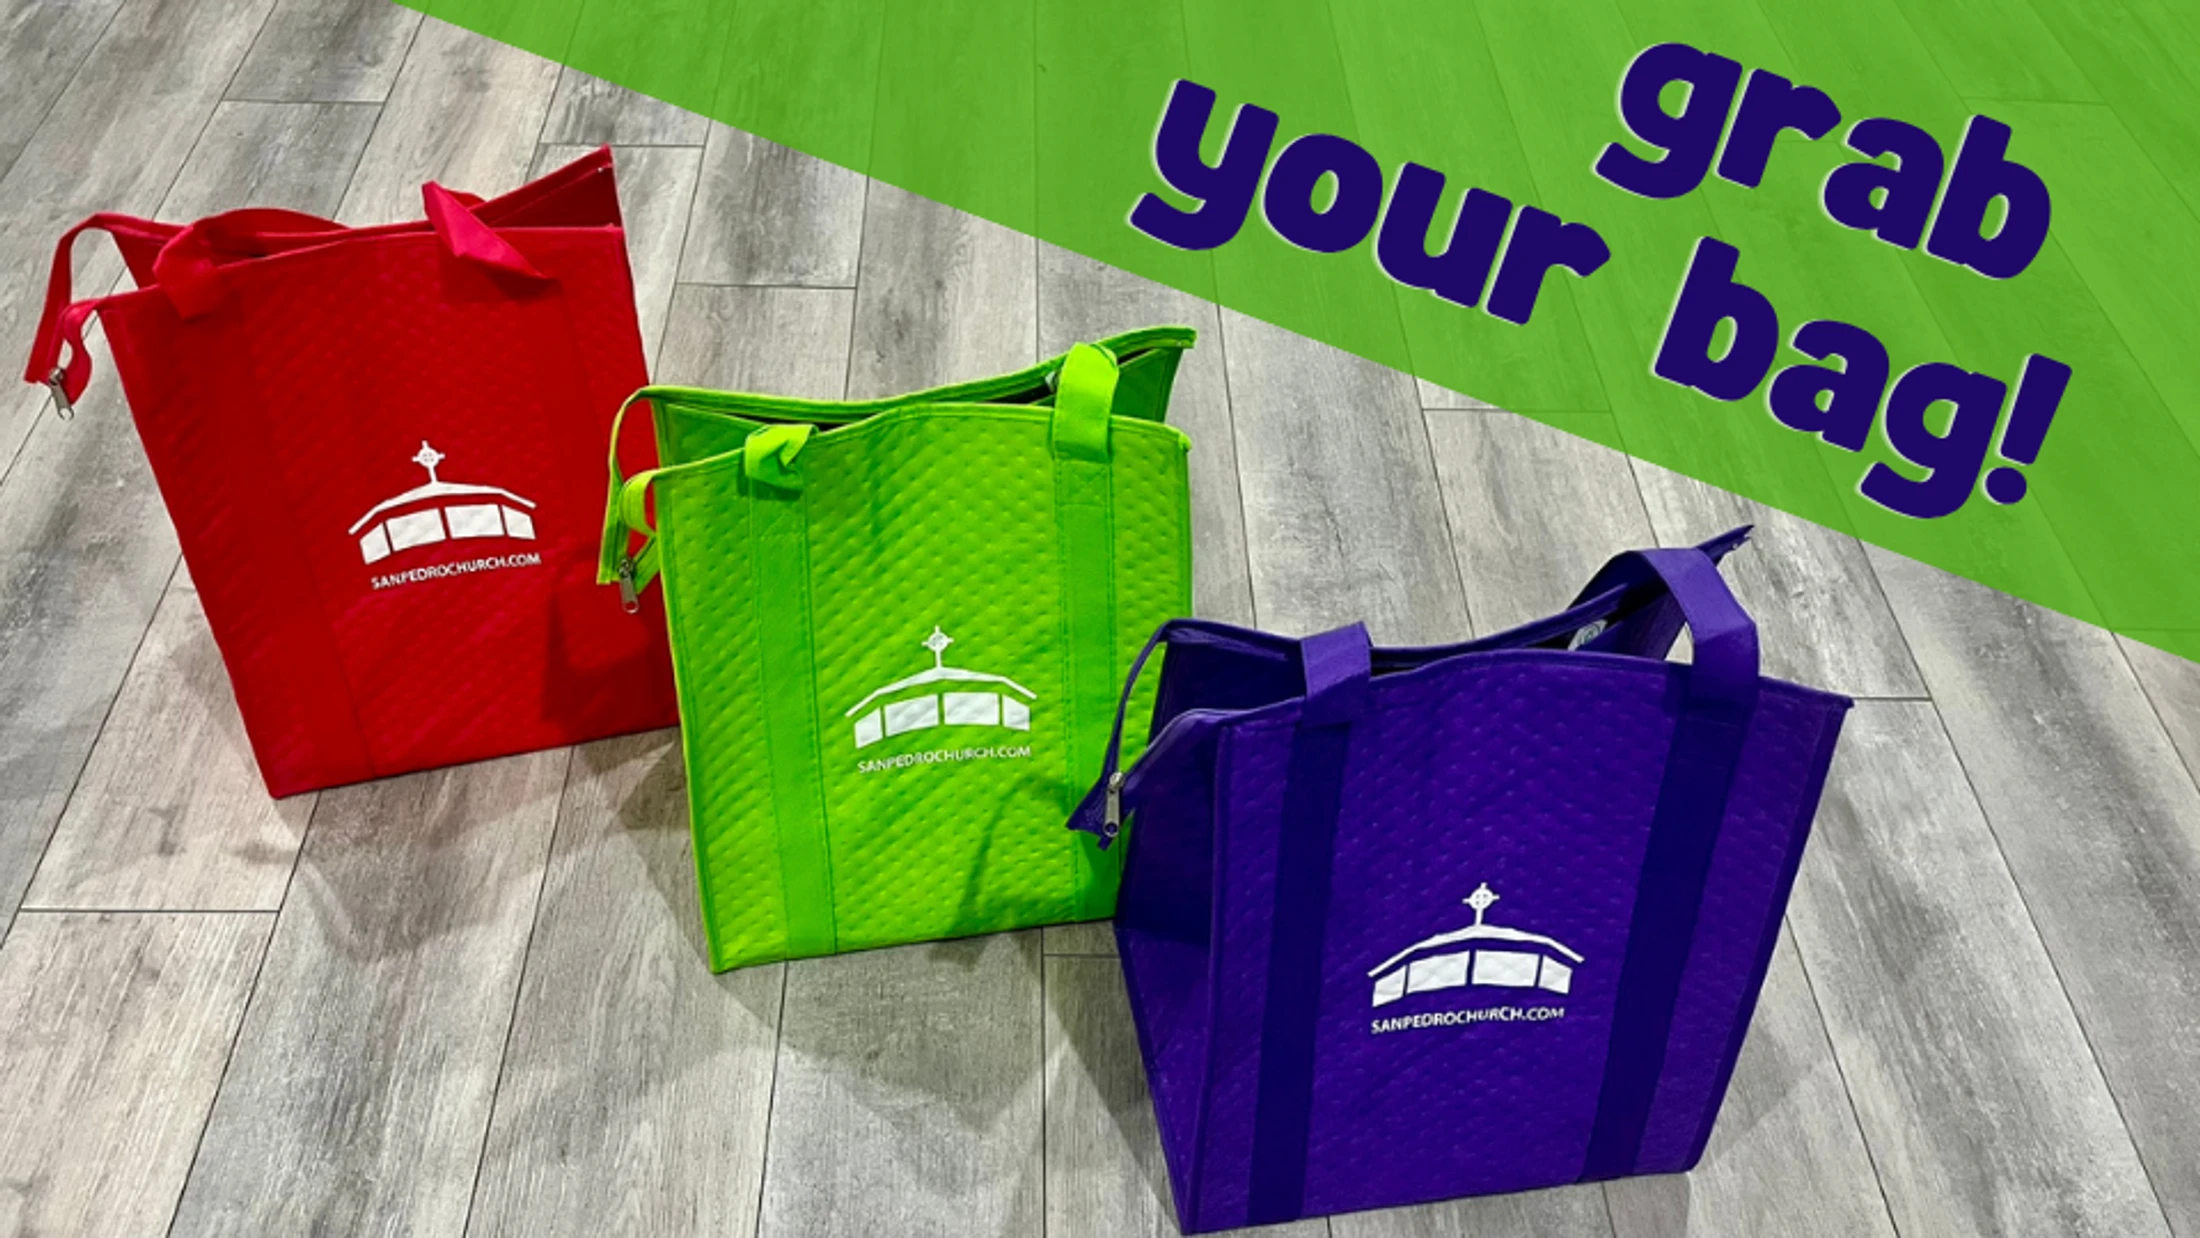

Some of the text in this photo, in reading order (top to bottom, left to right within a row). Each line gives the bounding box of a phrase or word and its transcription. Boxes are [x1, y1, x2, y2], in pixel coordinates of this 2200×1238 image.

[370, 552, 542, 589] SANPEDROCHURCH.COM
[857, 746, 1031, 773] SANPEDROCHURCH.COM
[1370, 1006, 1565, 1034] SANPEDROCHURCH.COM
